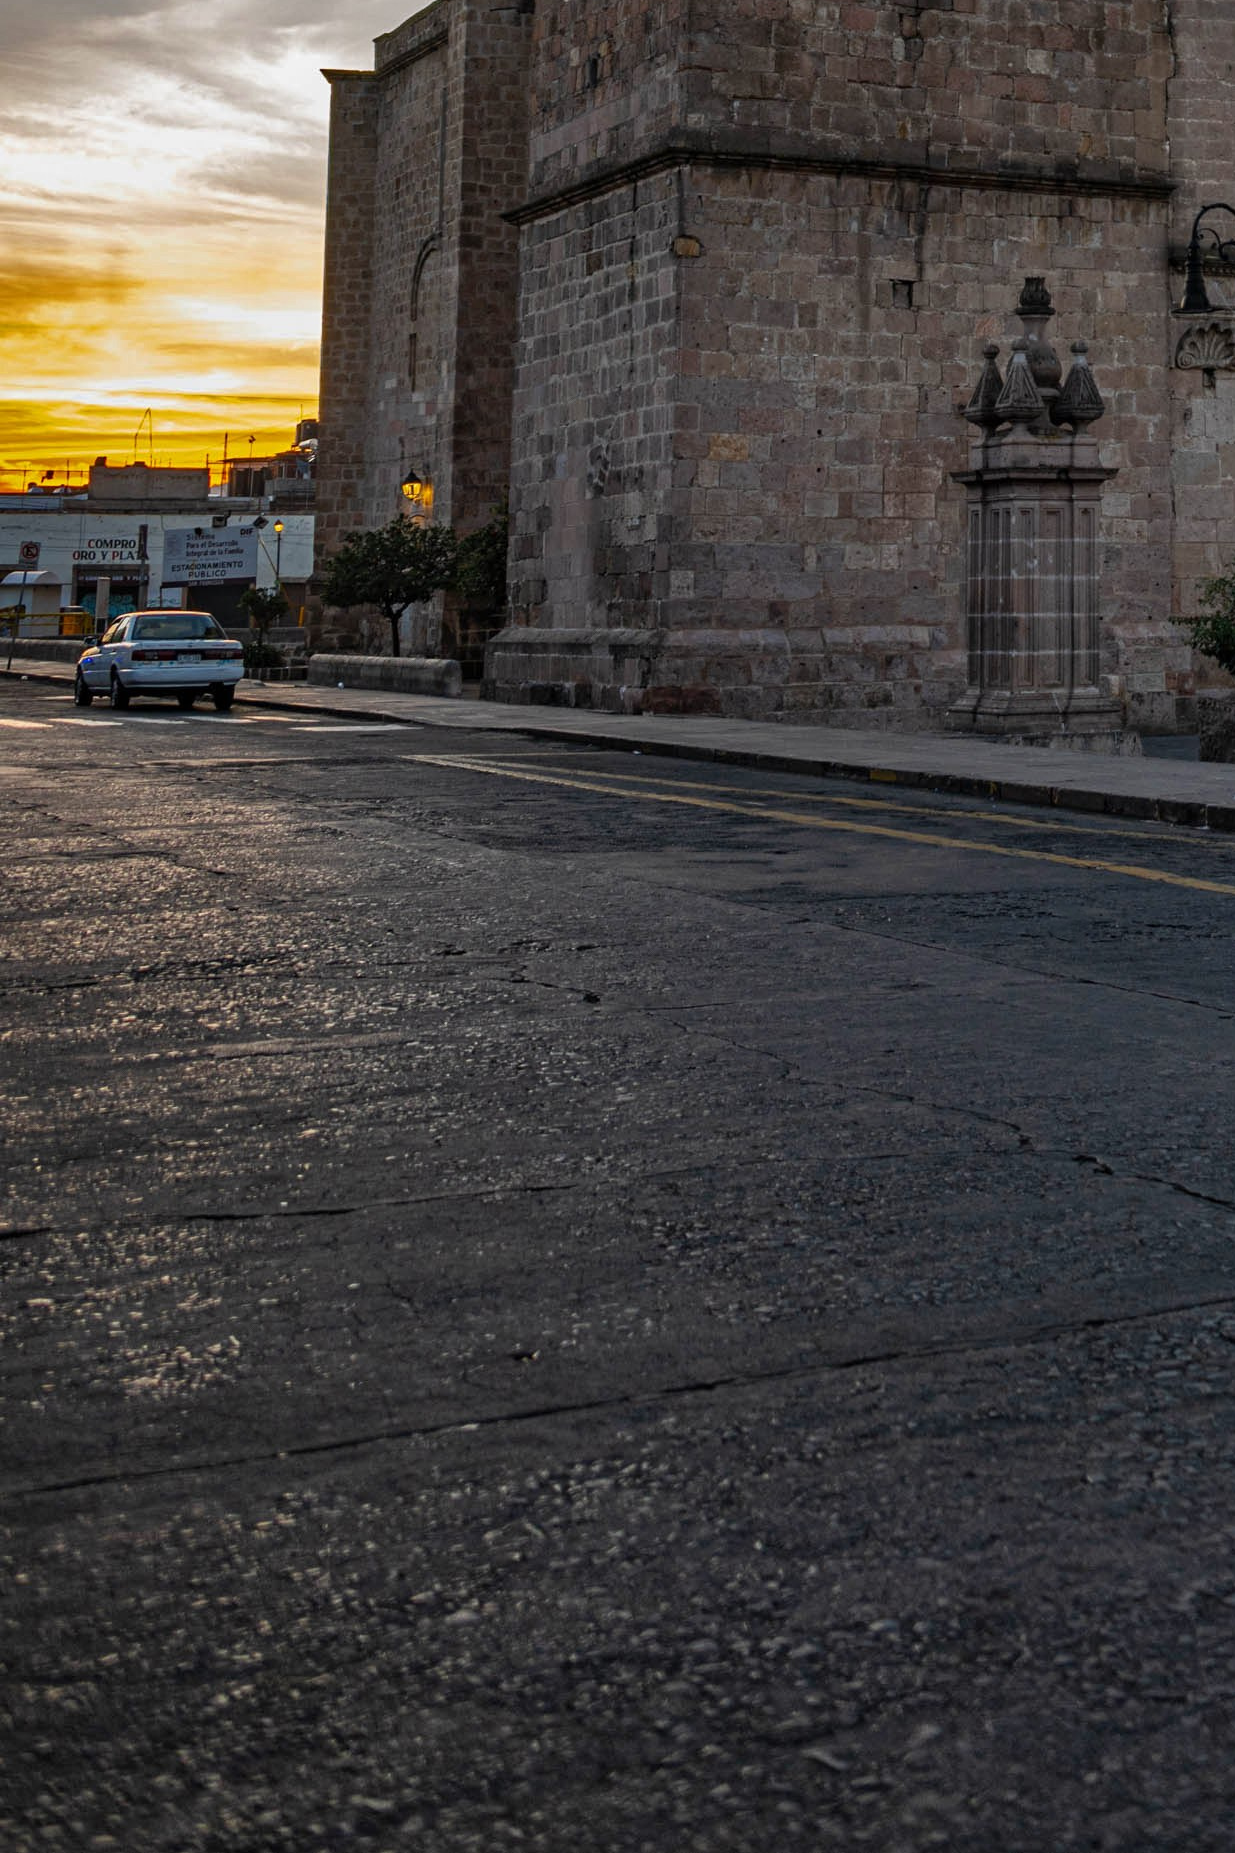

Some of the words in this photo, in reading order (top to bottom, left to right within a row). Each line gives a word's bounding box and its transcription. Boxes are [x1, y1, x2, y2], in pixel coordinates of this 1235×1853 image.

[88, 539, 136, 548] COMPRO
[72, 550, 96, 560] ORO
[100, 550, 108, 560] Y
[112, 550, 149, 560] PLA
[171, 561, 243, 572] ESTACIONAMIENTO
